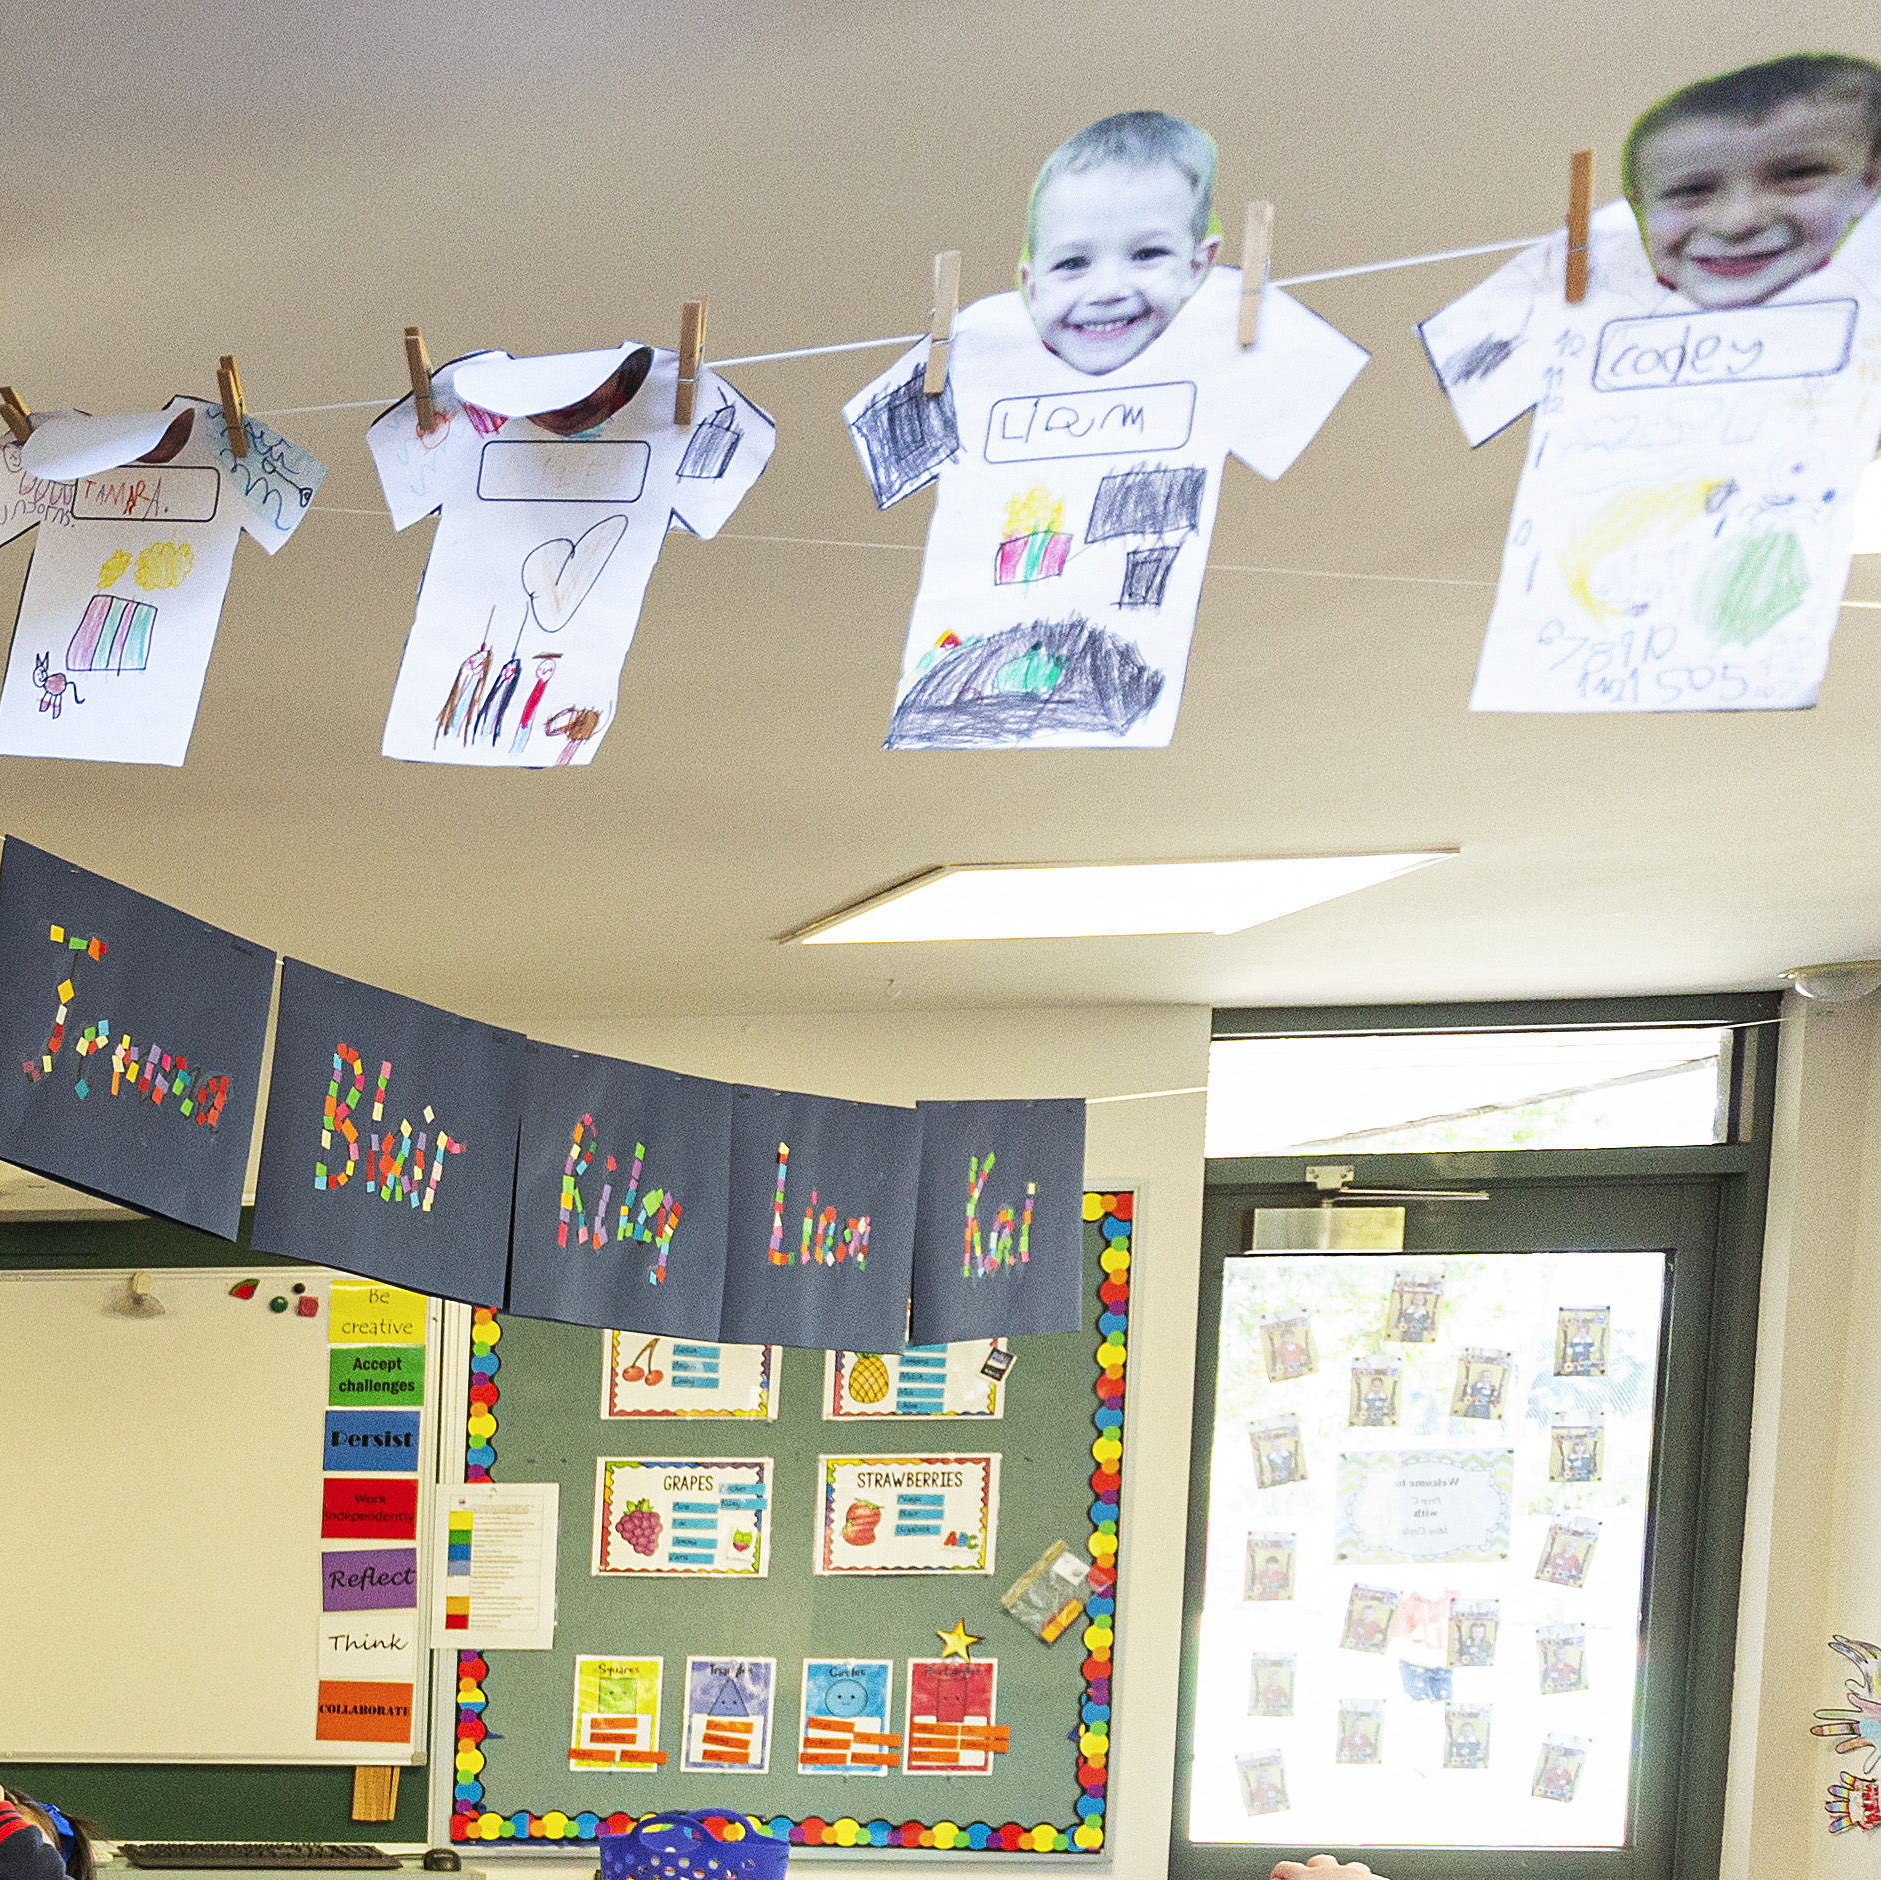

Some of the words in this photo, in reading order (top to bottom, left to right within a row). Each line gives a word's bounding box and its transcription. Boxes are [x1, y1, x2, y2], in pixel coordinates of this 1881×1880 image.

[963, 1152, 1036, 1278] Kai
[369, 1288, 390, 1305] Be
[342, 1318, 414, 1337] creative
[352, 1356, 403, 1375] Accept
[338, 1377, 416, 1395] challenges
[331, 1429, 413, 1448] Persist
[664, 1475, 713, 1492] GRAPES
[857, 1472, 963, 1489] STRAWBERRIES
[354, 1493, 386, 1506] Work
[324, 1509, 416, 1526] independently
[943, 1531, 979, 1549] ABC
[329, 1566, 416, 1590] Reflect
[328, 1633, 408, 1653] Think
[598, 1664, 639, 1676] Squares
[828, 1666, 867, 1678] Circles
[319, 1704, 411, 1718] COLLABORATE
